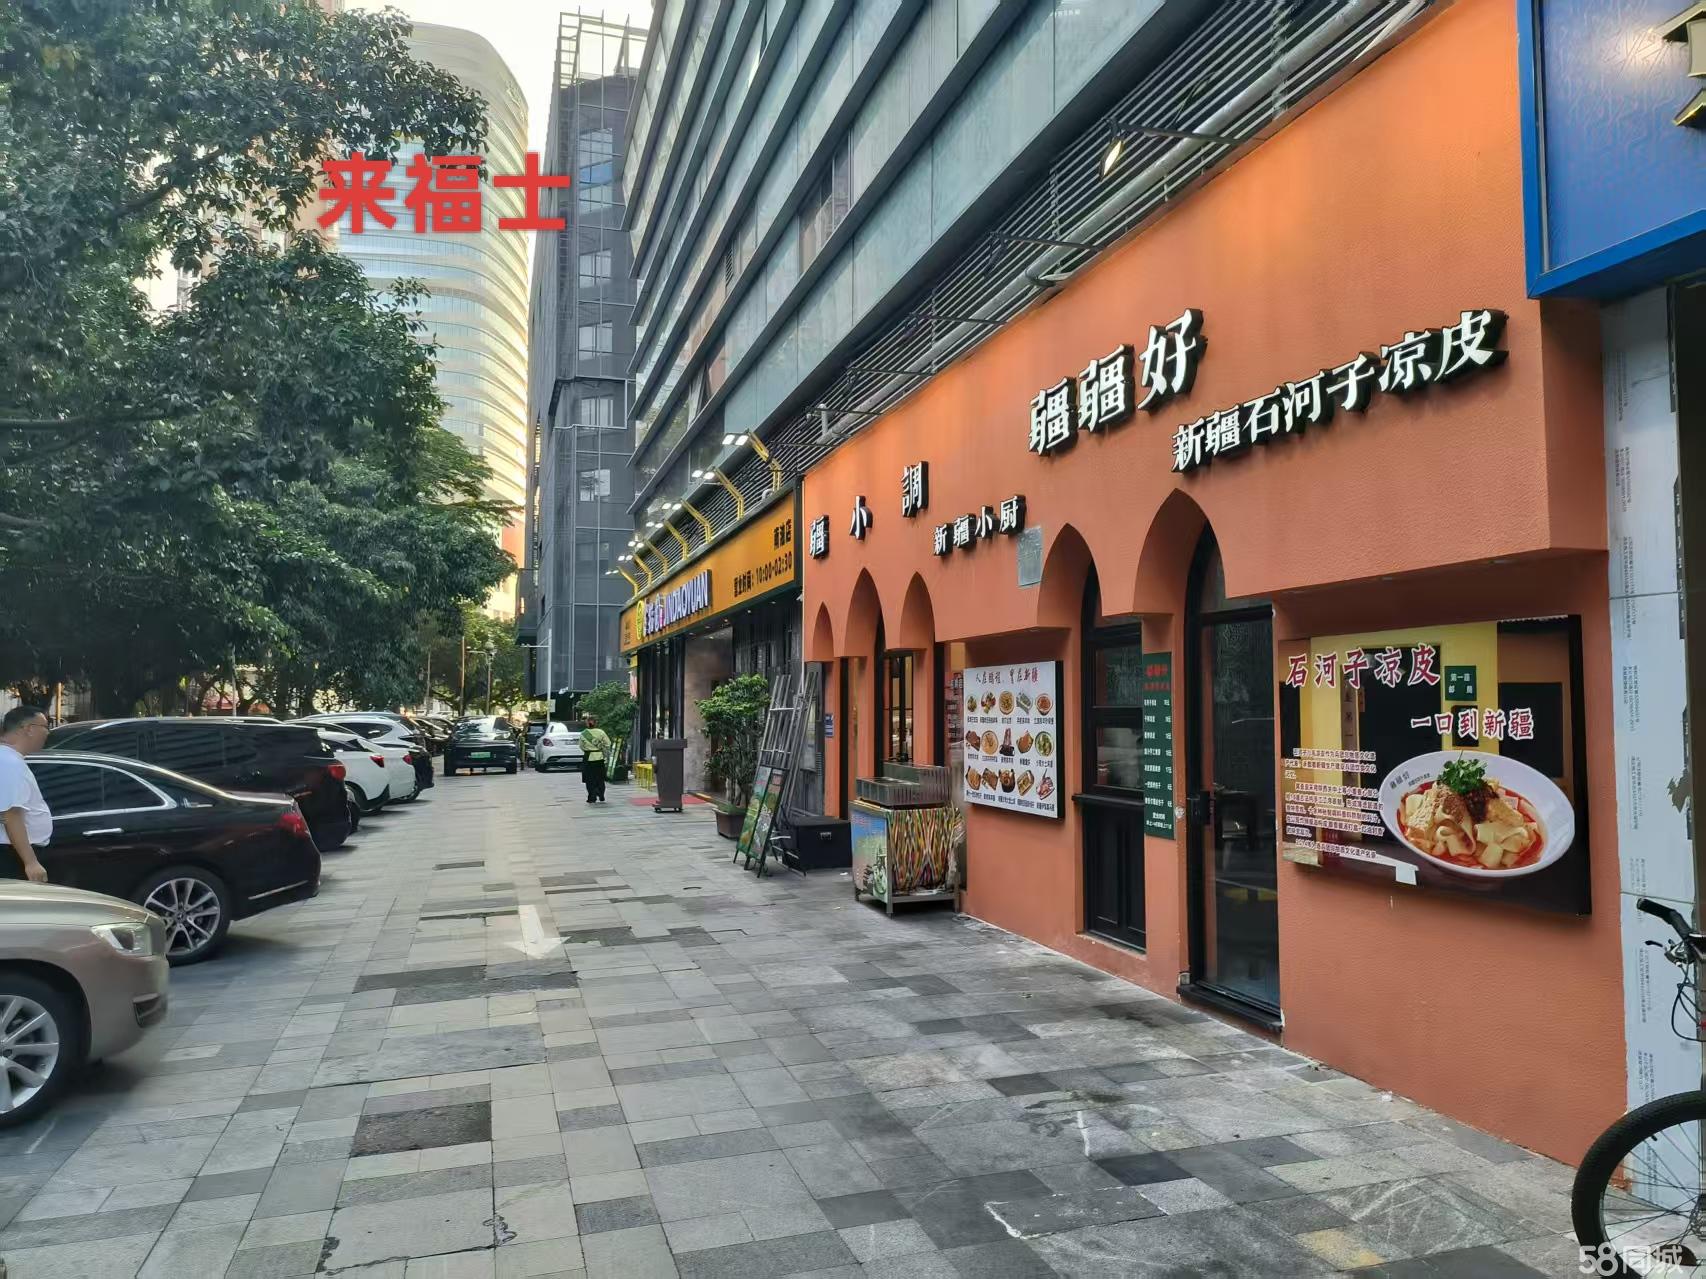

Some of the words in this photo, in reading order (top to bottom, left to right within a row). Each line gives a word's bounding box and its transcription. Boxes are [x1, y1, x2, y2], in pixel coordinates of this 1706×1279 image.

[1027, 307, 1206, 456] 疆疆好
[1170, 308, 1508, 473] 新疆石河子凉皮
[933, 494, 1026, 556] 新疆小厨
[1285, 642, 1441, 690] 石河子凉皮
[1410, 707, 1534, 741] 一口到新疆
